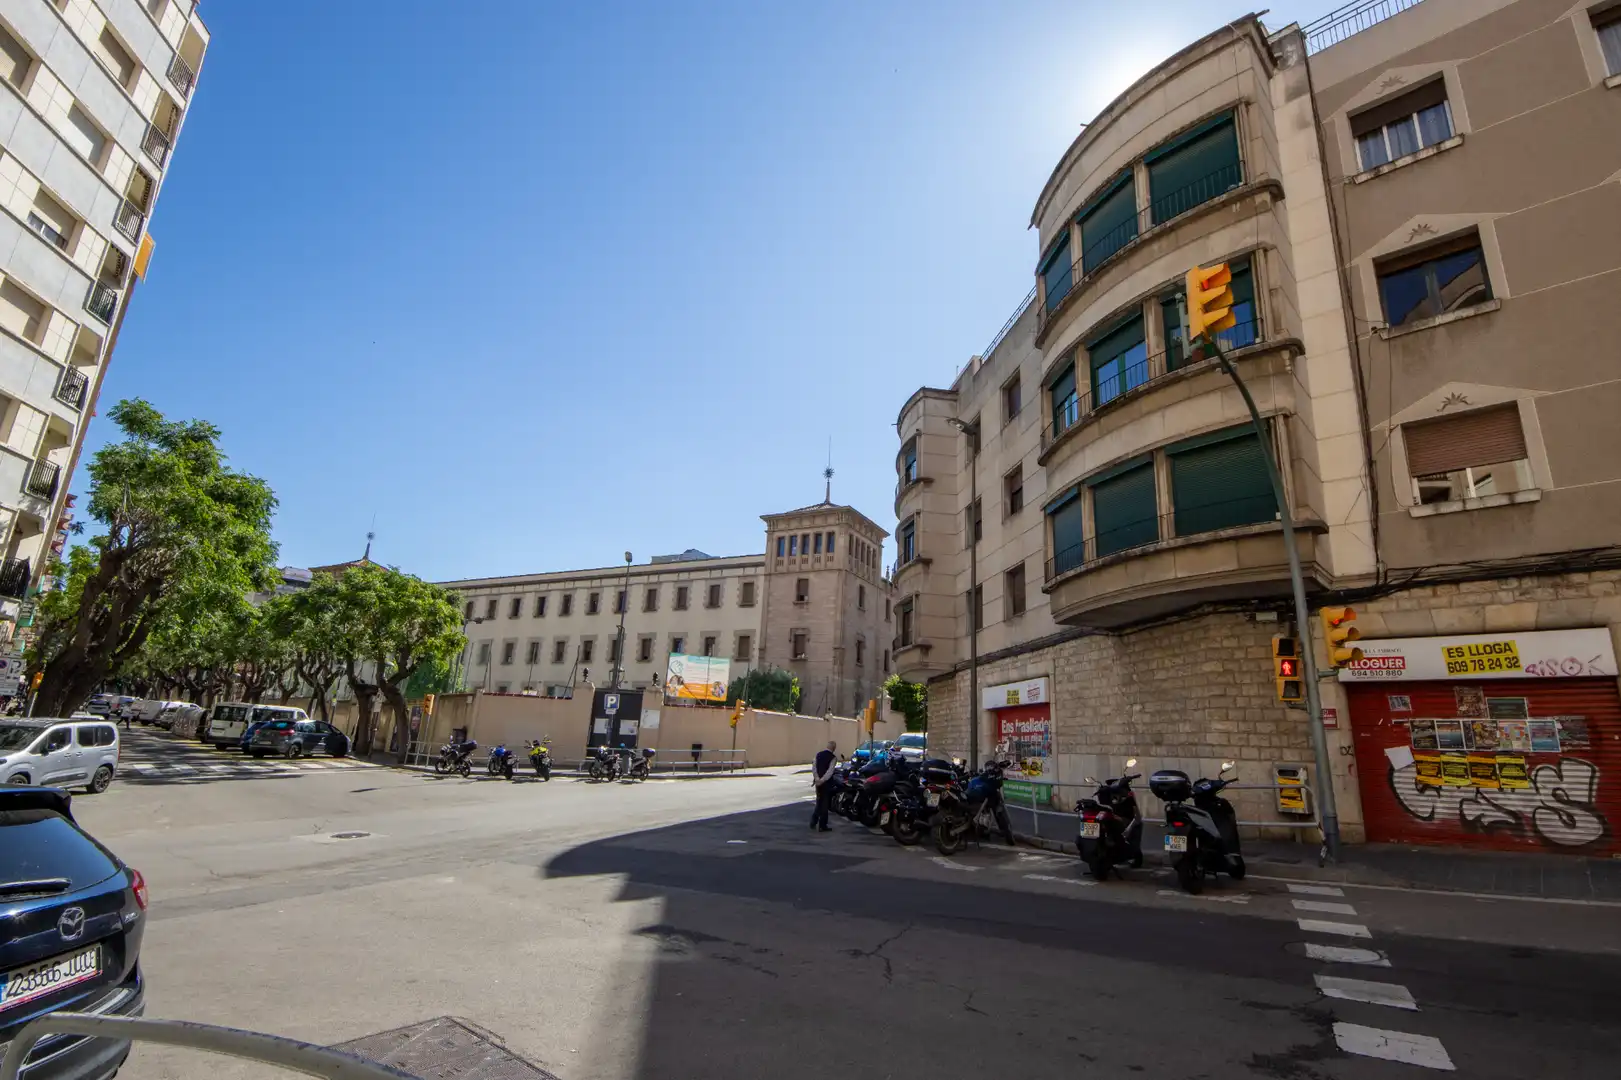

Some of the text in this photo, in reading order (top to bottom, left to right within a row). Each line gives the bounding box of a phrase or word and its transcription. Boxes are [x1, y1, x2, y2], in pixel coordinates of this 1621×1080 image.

[1446, 642, 1513, 658] ES LLOGA
[1349, 658, 1404, 669] LLOGUER
[1447, 660, 1468, 673] 609
[1470, 659, 1485, 671] 78
[1487, 658, 1503, 670] 24
[1504, 656, 1521, 669] 32
[607, 695, 617, 708] P
[1001, 719, 1014, 734] Ens
